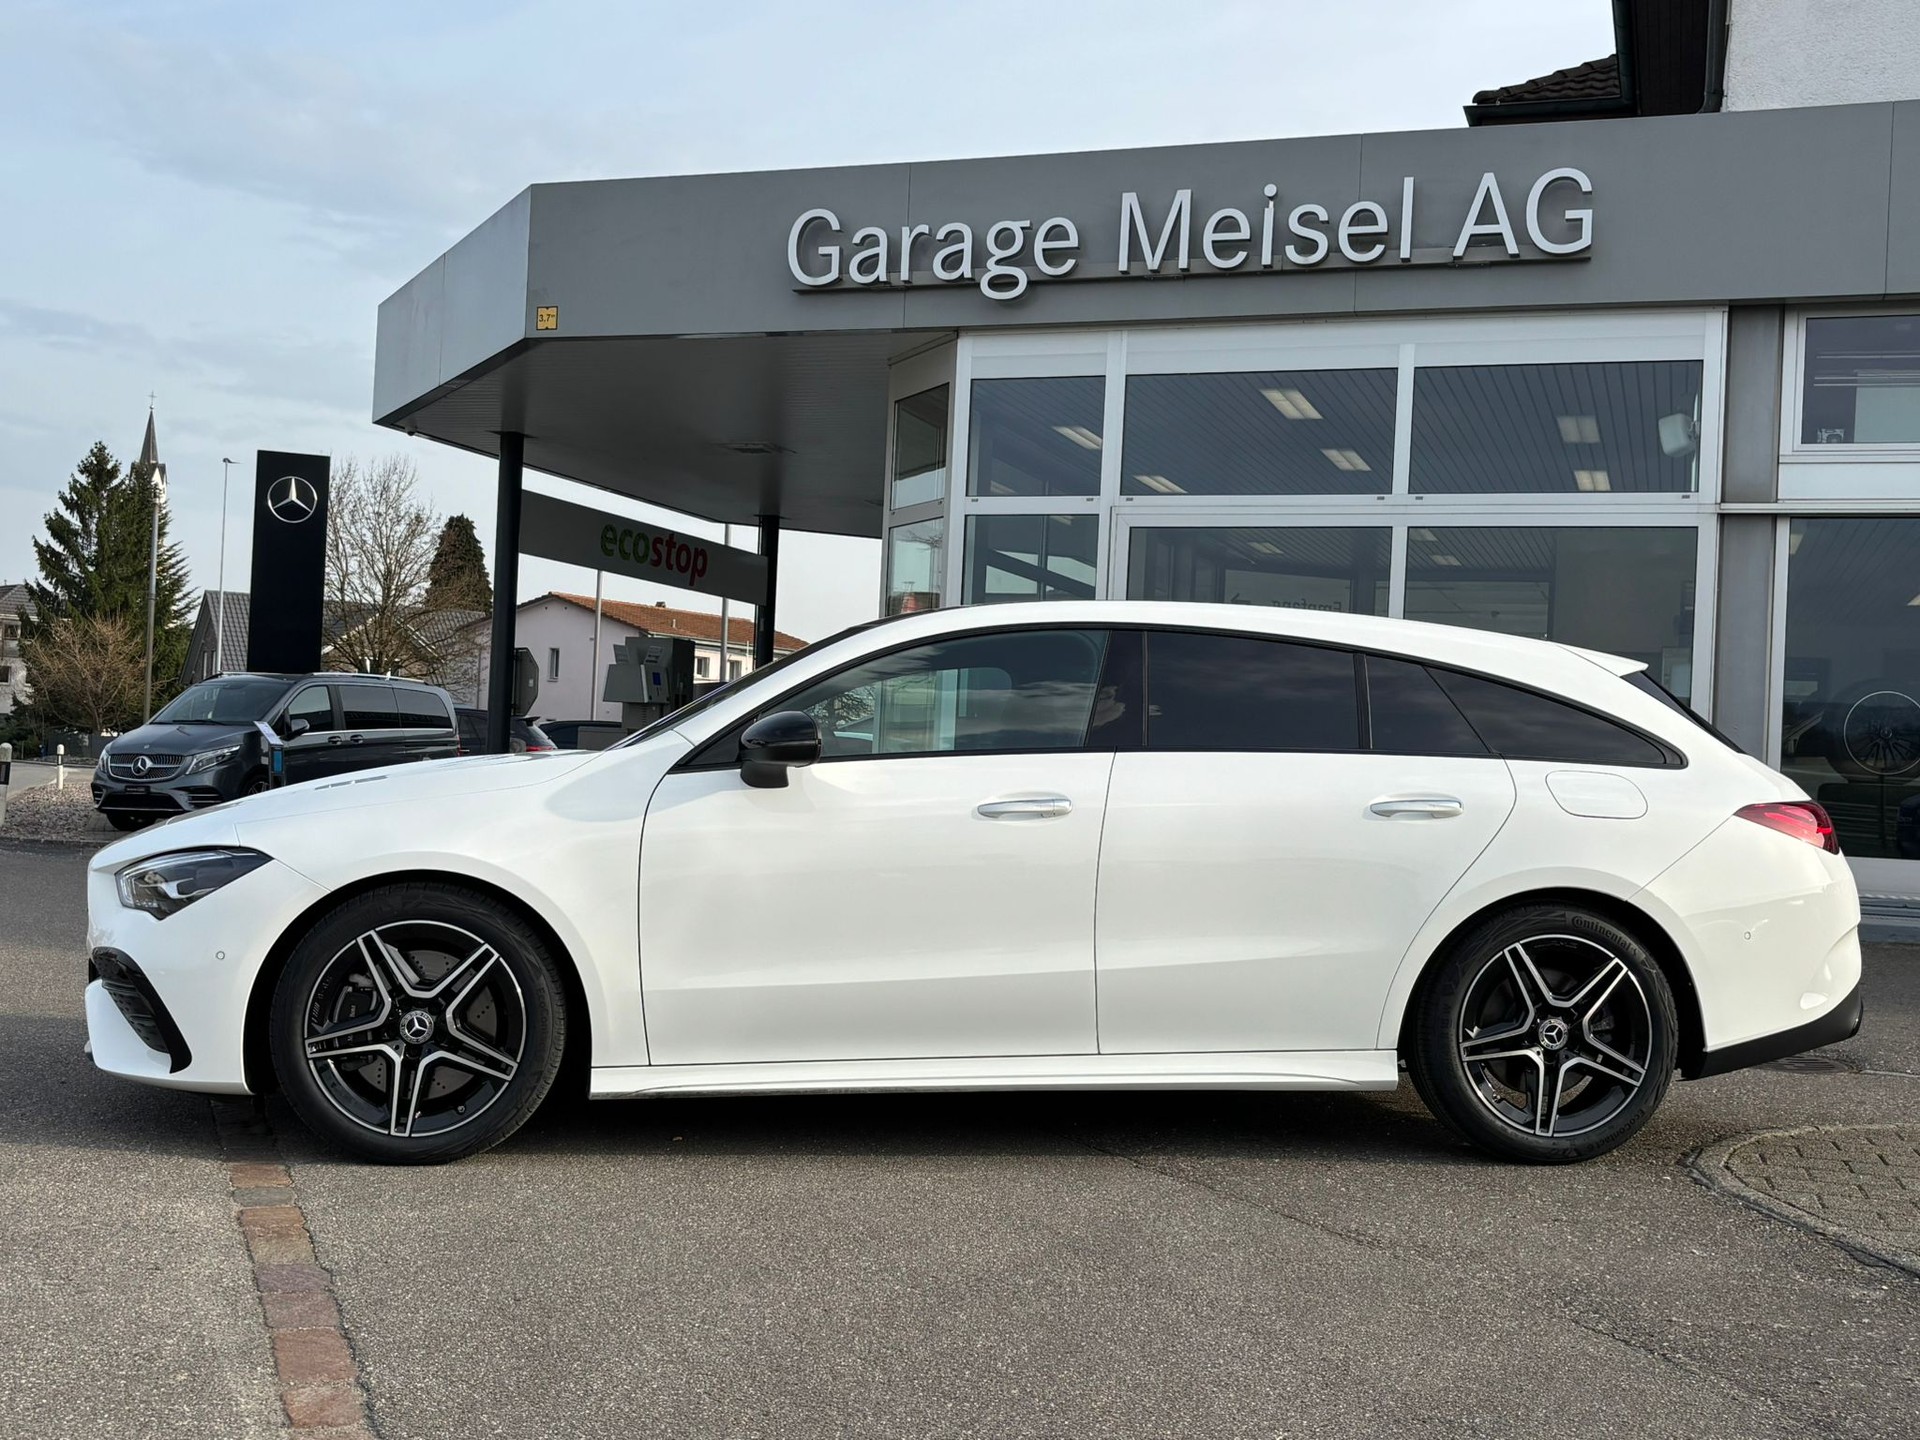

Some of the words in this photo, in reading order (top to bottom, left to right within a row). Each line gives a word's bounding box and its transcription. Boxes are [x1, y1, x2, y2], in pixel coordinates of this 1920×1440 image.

[787, 207, 1080, 300] Garage
[1118, 175, 1415, 274] Meisel
[1452, 167, 1594, 260] AG
[600, 523, 708, 586] ecostop
[1571, 915, 1632, 952] Continental
[1596, 1109, 1645, 1148] EcoContact
